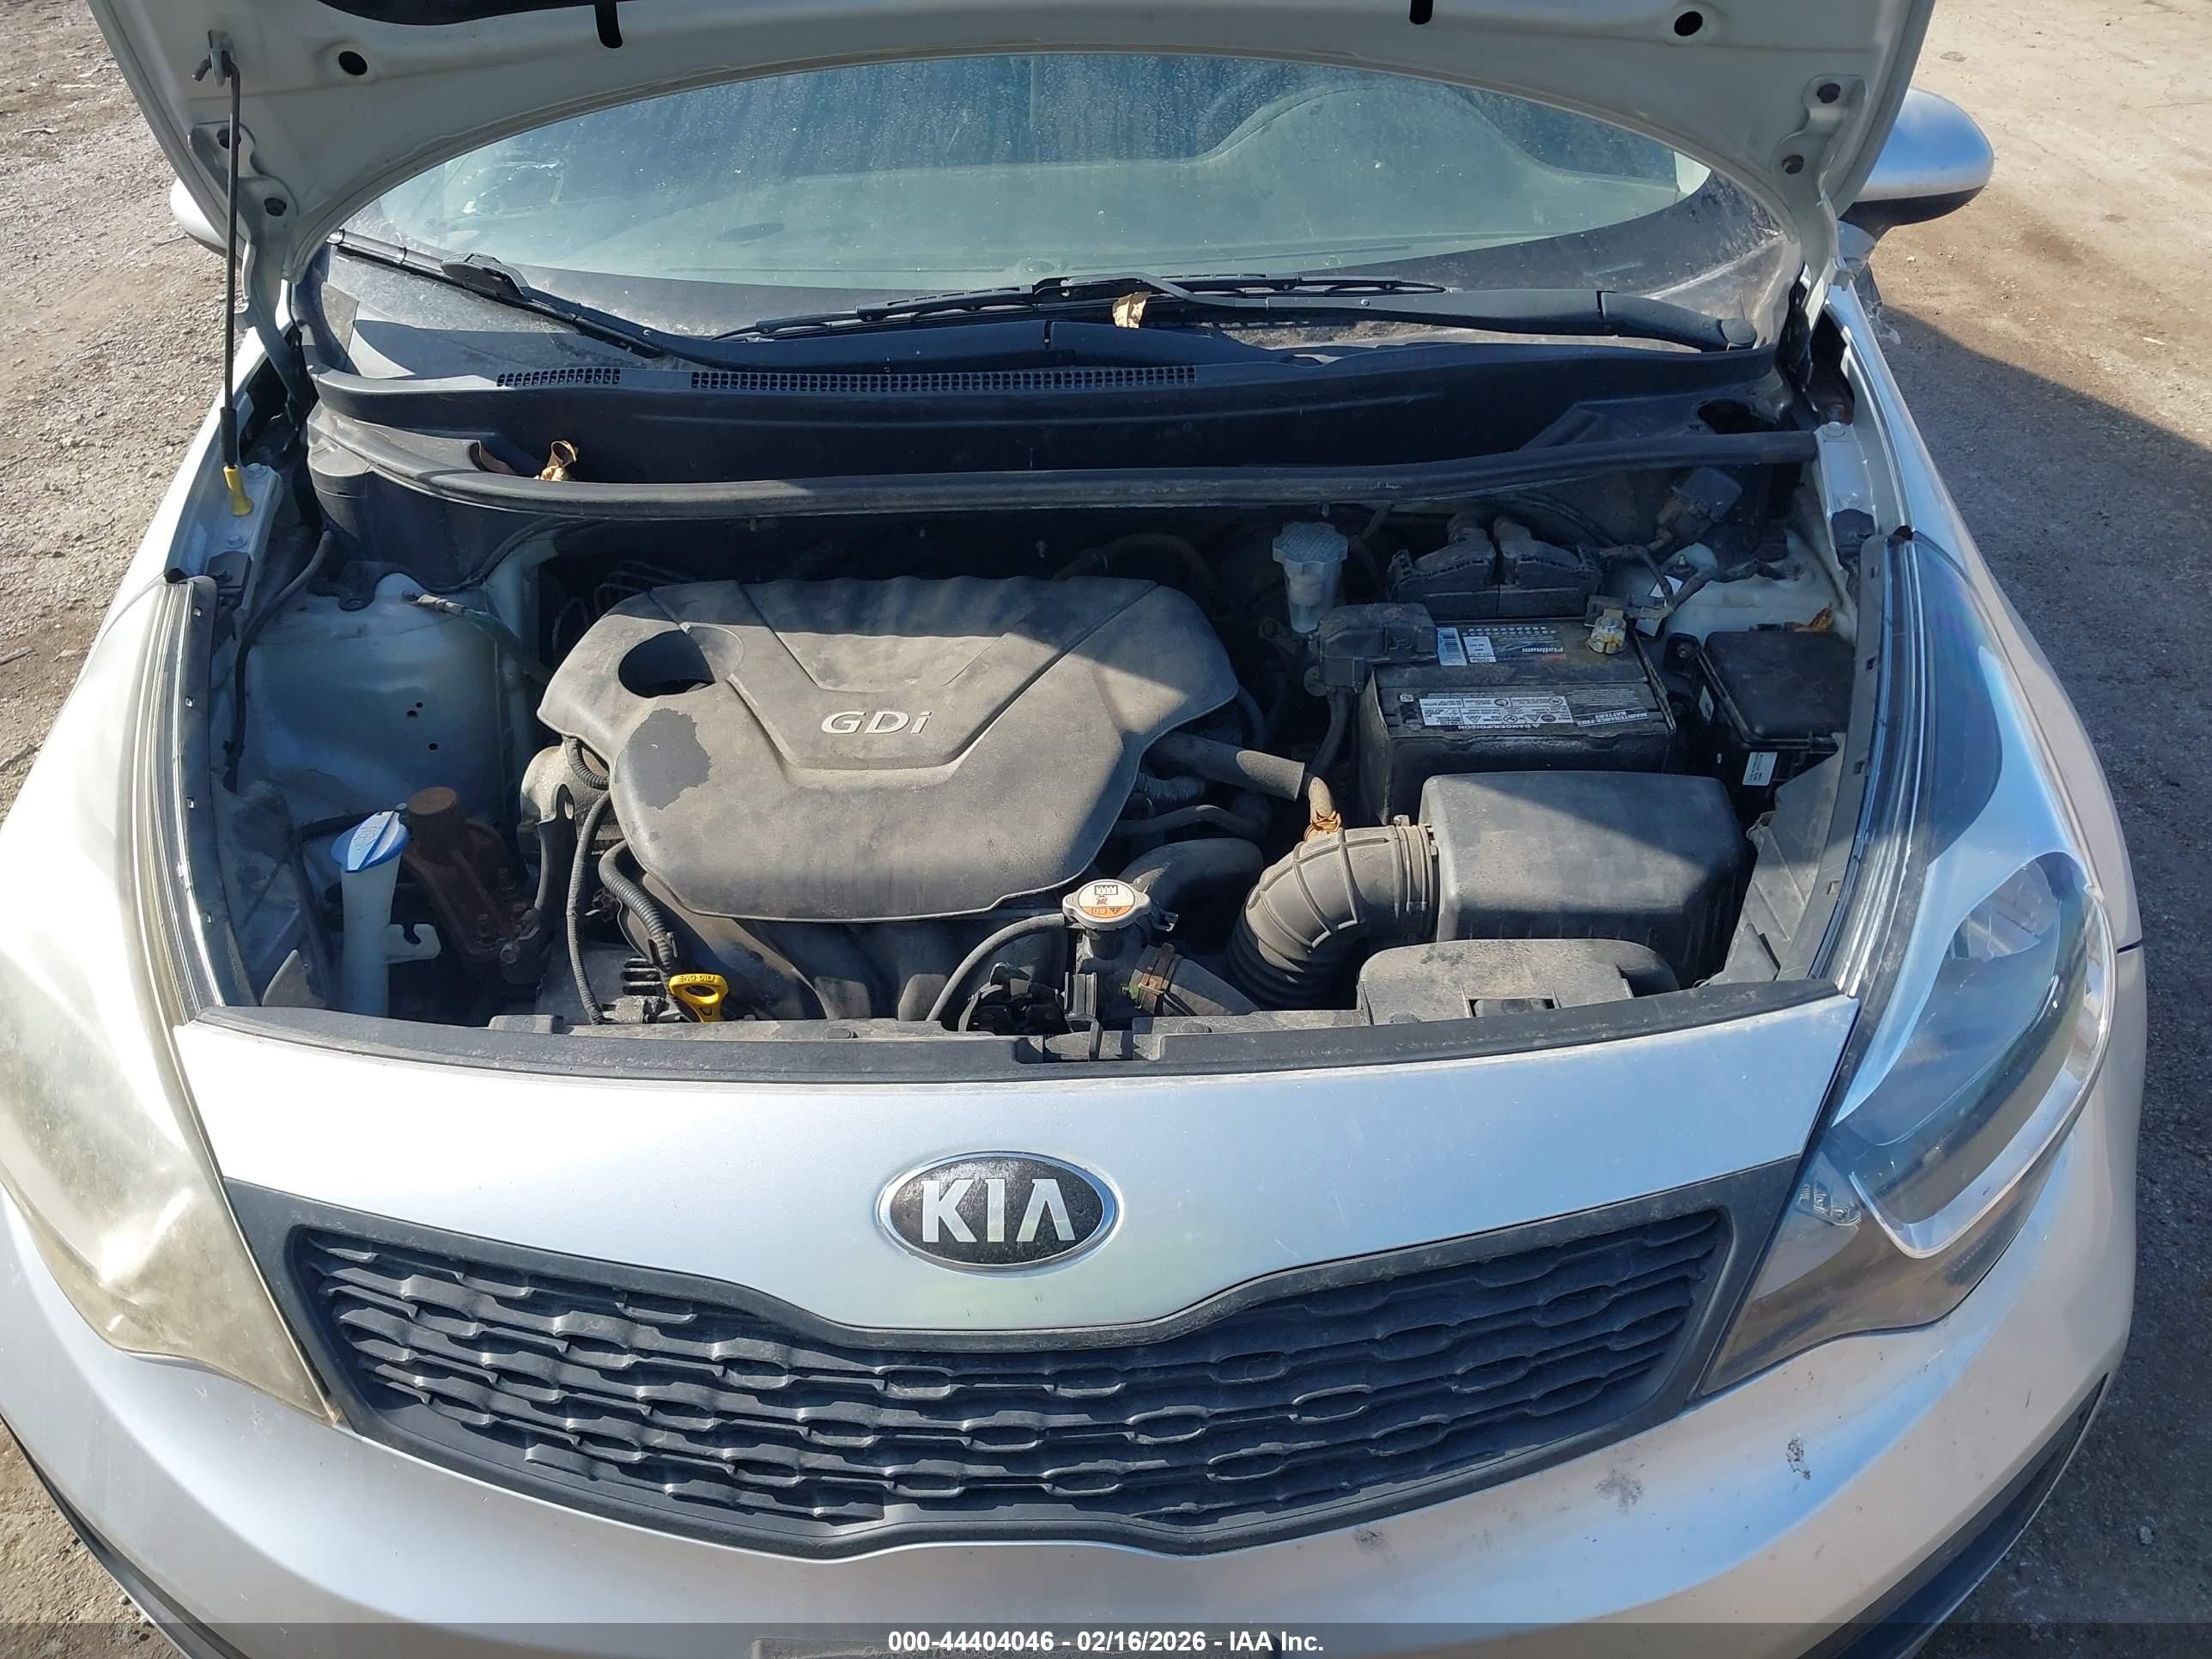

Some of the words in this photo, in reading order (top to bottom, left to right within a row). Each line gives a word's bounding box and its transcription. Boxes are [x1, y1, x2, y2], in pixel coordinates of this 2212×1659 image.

[821, 710, 933, 734] GDi
[1578, 713, 1648, 726] MAINTENANCE-FREE
[921, 1178, 1077, 1243] KIA
